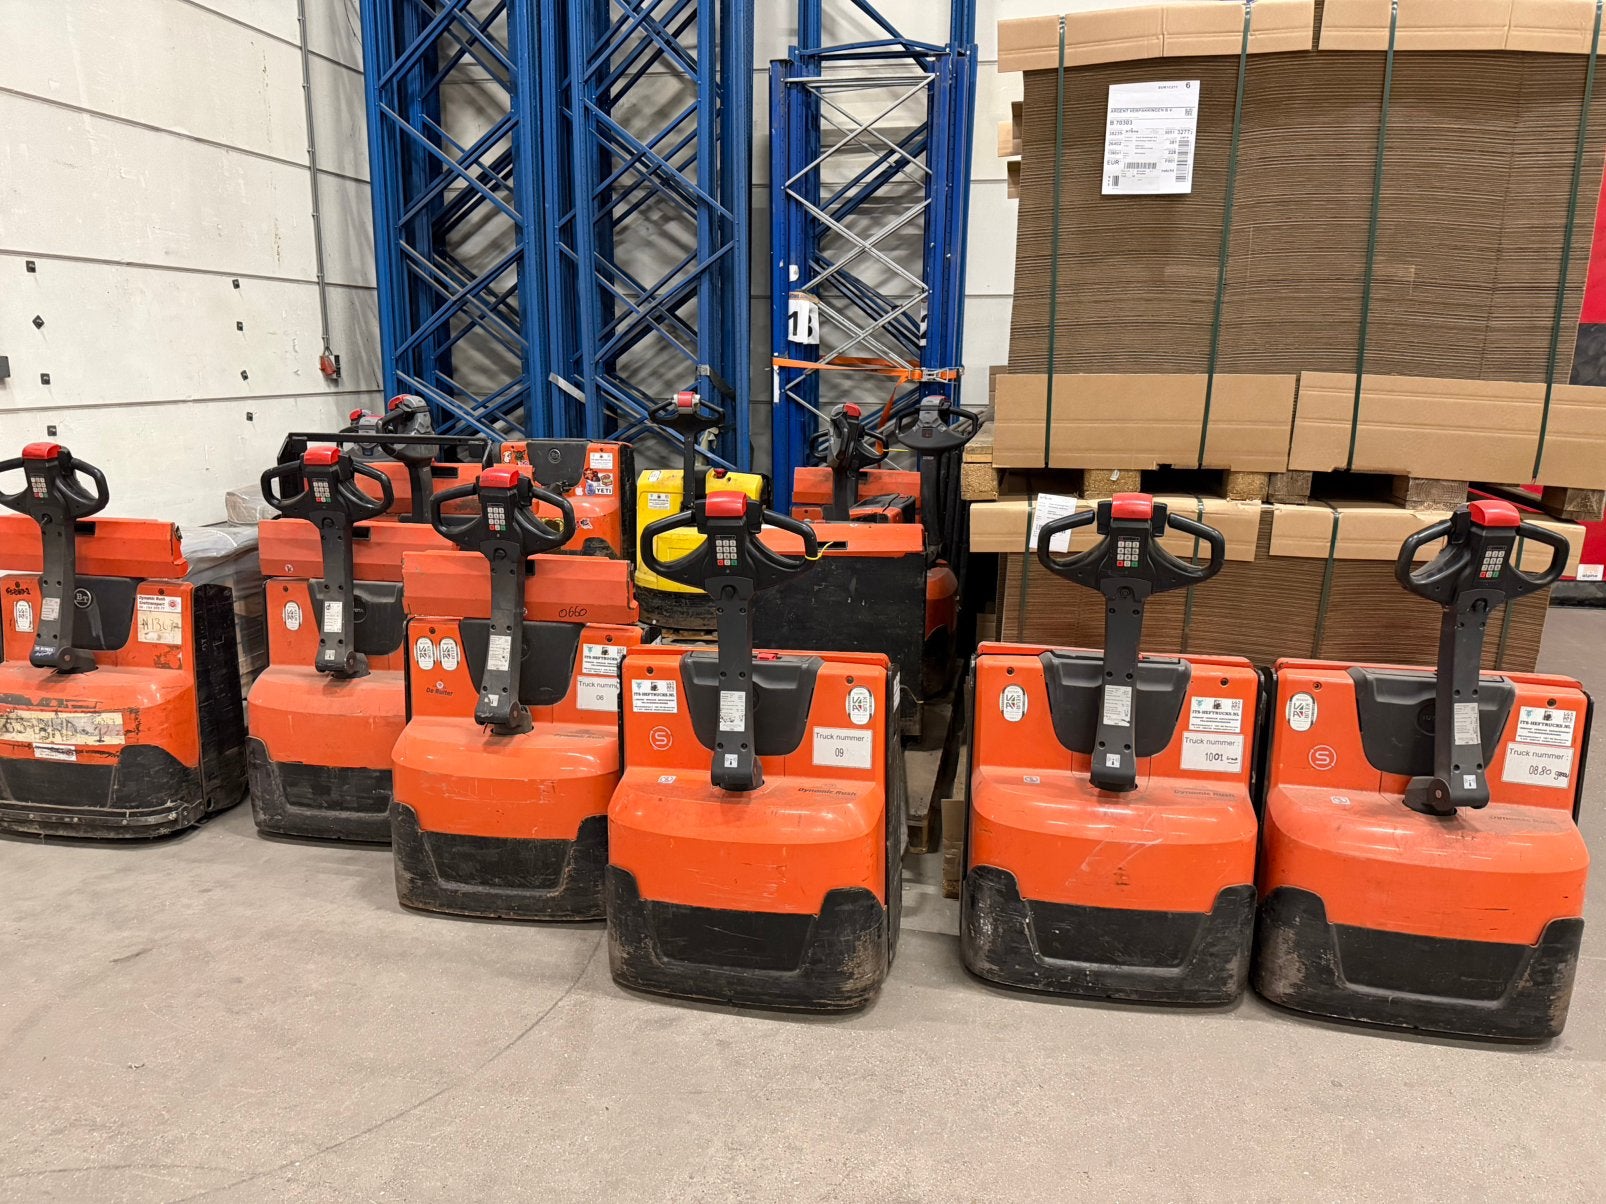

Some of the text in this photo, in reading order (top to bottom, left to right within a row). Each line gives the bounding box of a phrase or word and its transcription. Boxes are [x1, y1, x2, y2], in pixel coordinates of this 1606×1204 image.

[76, 593, 88, 602] BT
[558, 608, 588, 618] 0660
[835, 748, 844, 757] 09
[1205, 752, 1223, 761] 1001
[1509, 748, 1530, 757] Truck
[1532, 752, 1564, 760] nummer
